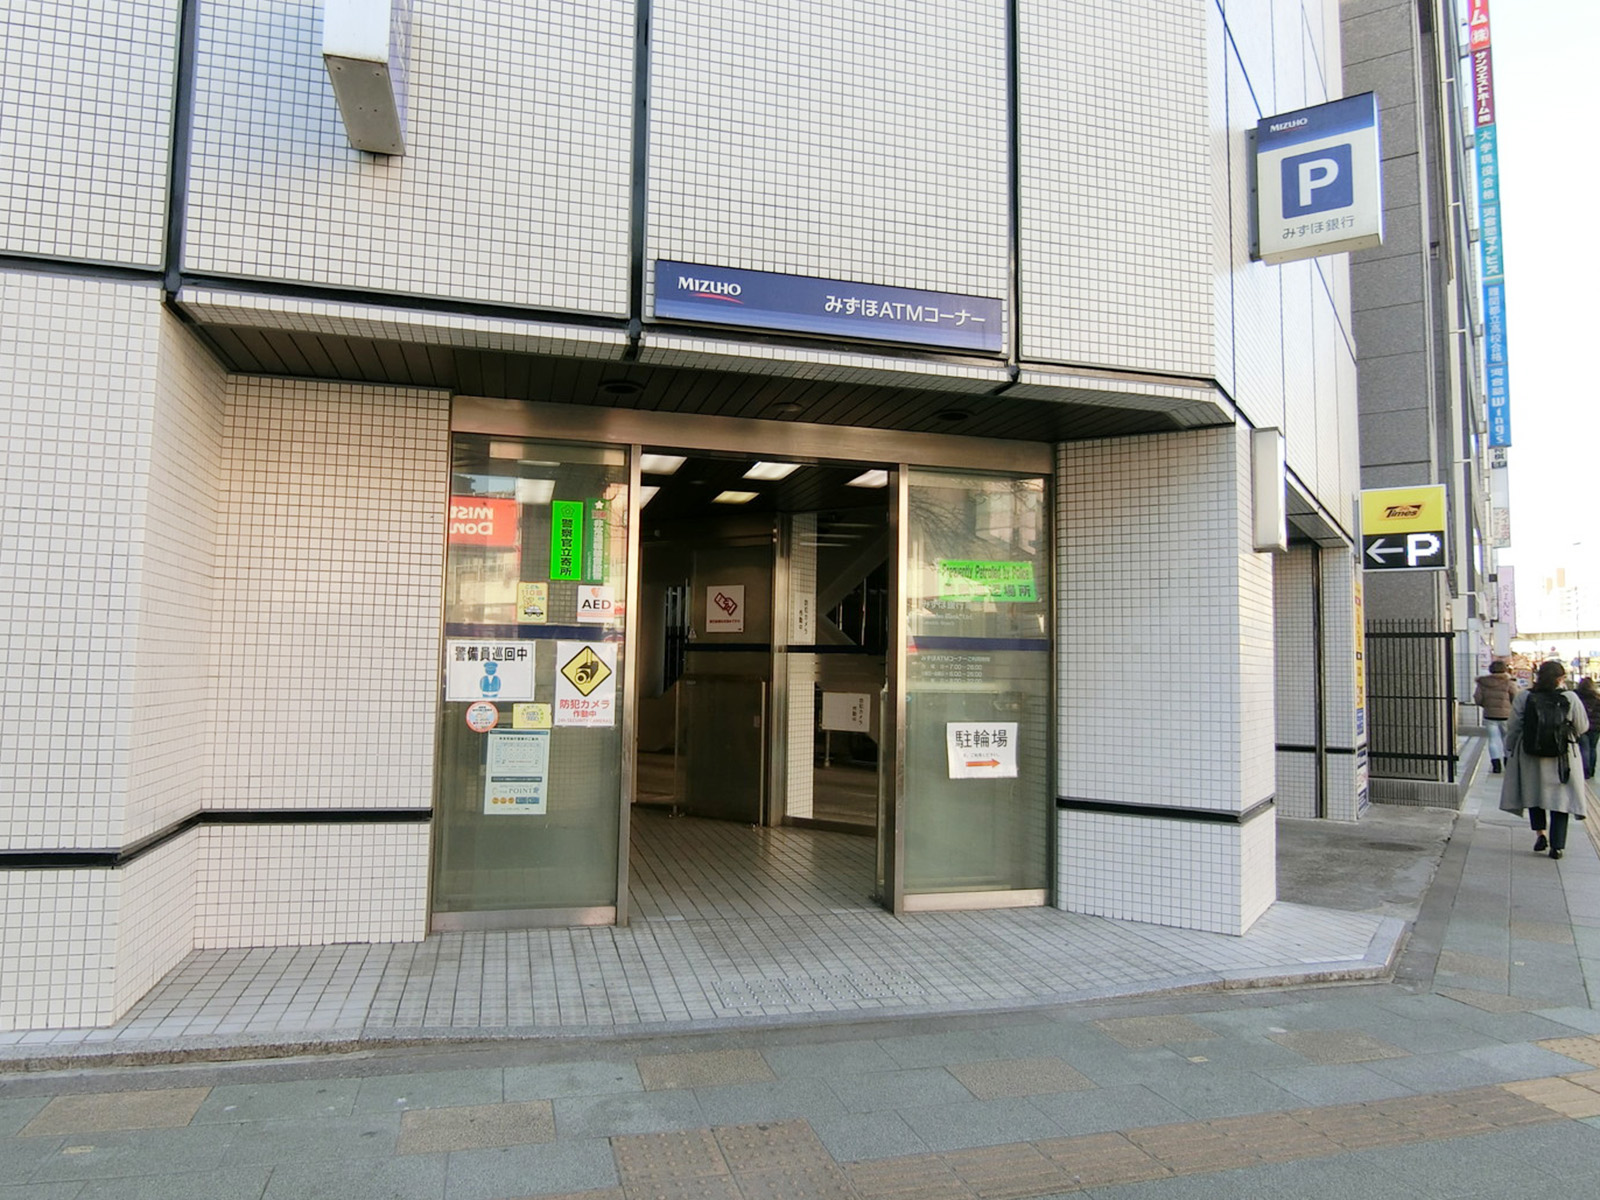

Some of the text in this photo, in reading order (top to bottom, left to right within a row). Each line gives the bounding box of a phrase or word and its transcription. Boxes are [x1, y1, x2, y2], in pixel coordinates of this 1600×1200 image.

[1270, 117, 1308, 133] MIZUHO
[1298, 158, 1339, 207] P
[1282, 215, 1355, 239] みずほ銀行
[677, 276, 742, 297] MIZUHO
[824, 293, 986, 326] みずほATMコーナー
[1385, 504, 1422, 518] Times
[560, 519, 574, 576] 警察官立寄所
[1407, 533, 1441, 566] P
[582, 599, 611, 610] AED
[455, 646, 528, 662] 警備員巡回中
[559, 699, 611, 710] 防犯カメラ
[573, 710, 597, 718] 作動中
[955, 729, 1009, 749] 駐輪場
